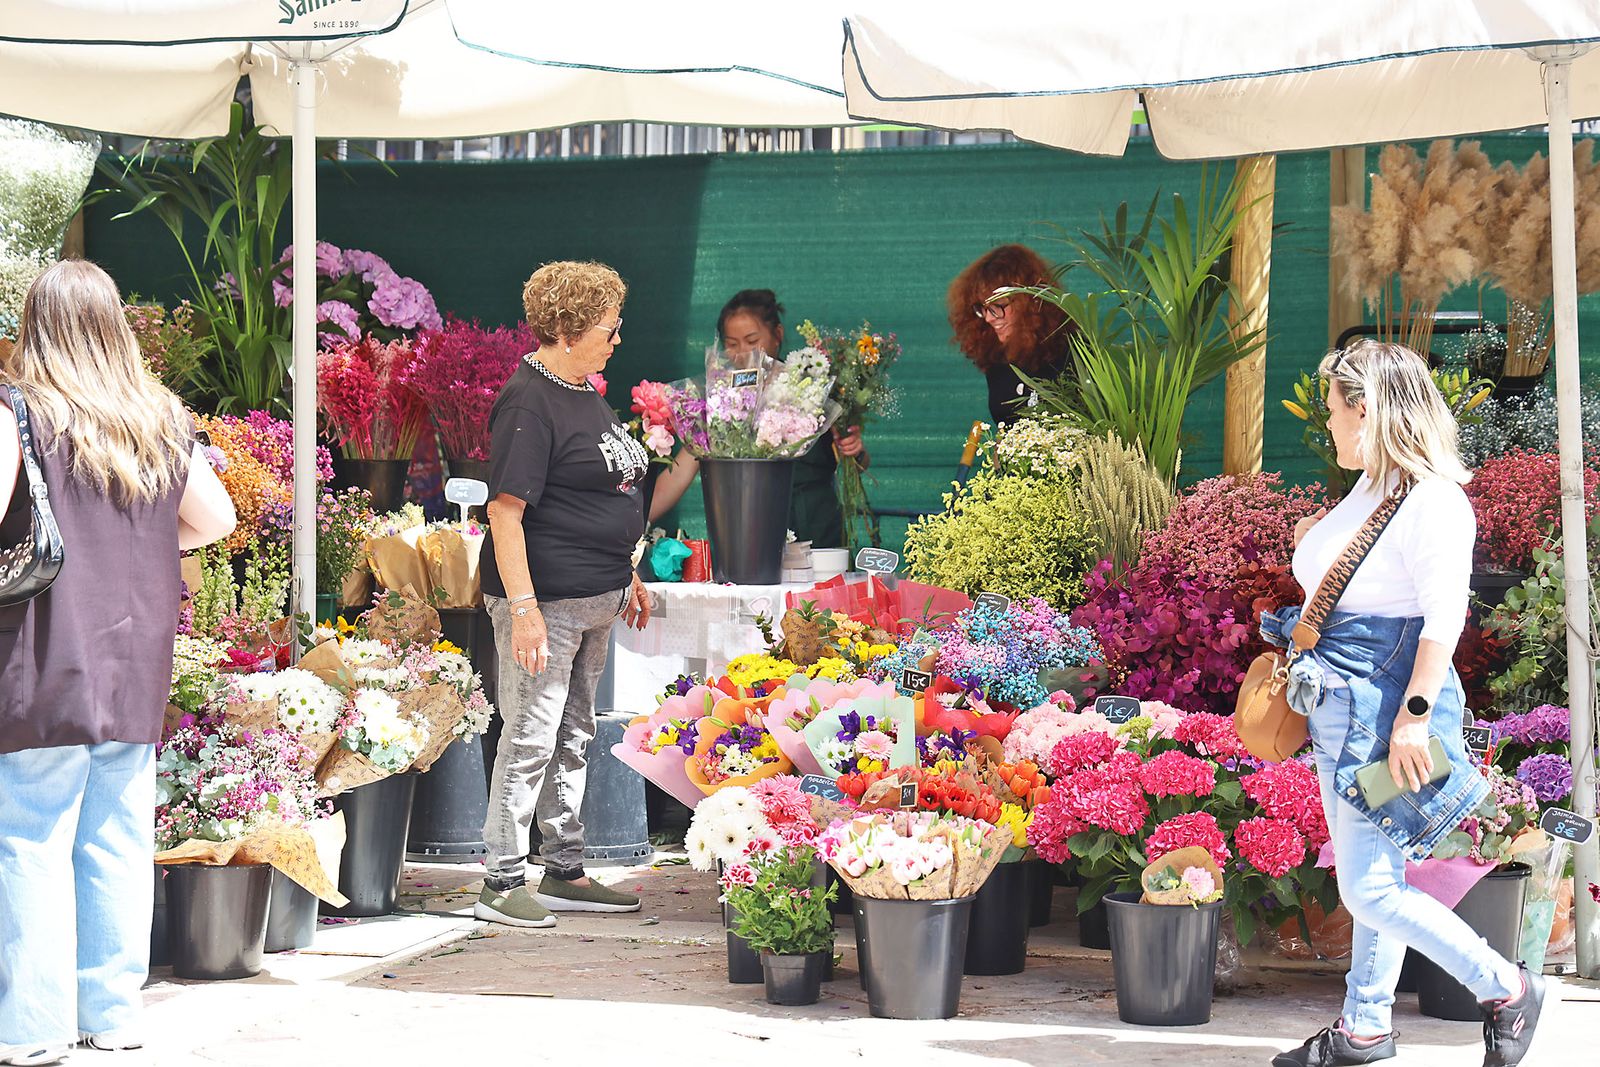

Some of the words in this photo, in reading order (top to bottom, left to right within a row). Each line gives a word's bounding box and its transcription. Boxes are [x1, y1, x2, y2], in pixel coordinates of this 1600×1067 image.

[313, 21, 336, 29] SINCE
[339, 20, 360, 28] 1890
[907, 672, 927, 688] 15€
[1554, 821, 1578, 838] 8€
